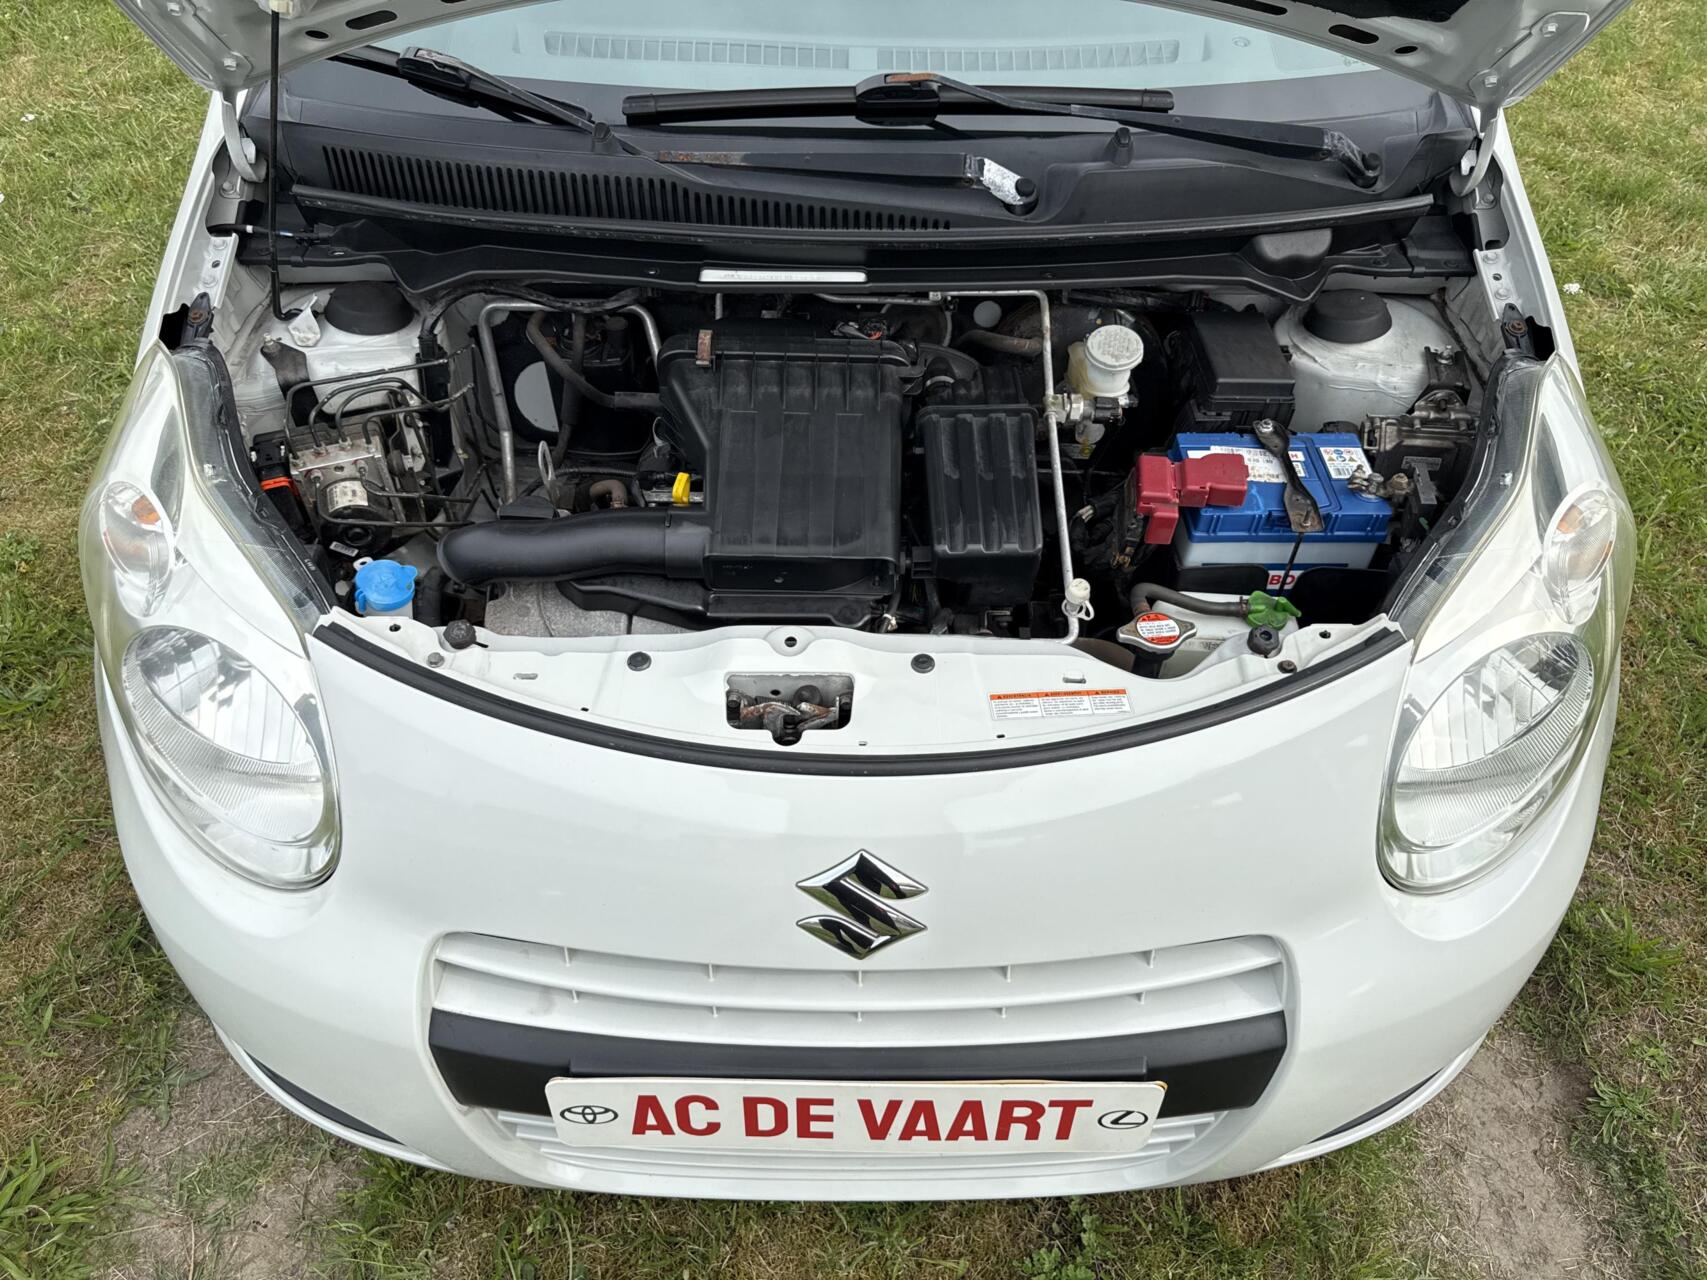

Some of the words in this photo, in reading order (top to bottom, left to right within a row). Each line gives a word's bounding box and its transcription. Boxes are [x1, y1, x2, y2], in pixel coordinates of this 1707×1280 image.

[632, 1095, 721, 1136] AC
[743, 1096, 834, 1139] DE
[857, 1099, 1093, 1141] VAART
